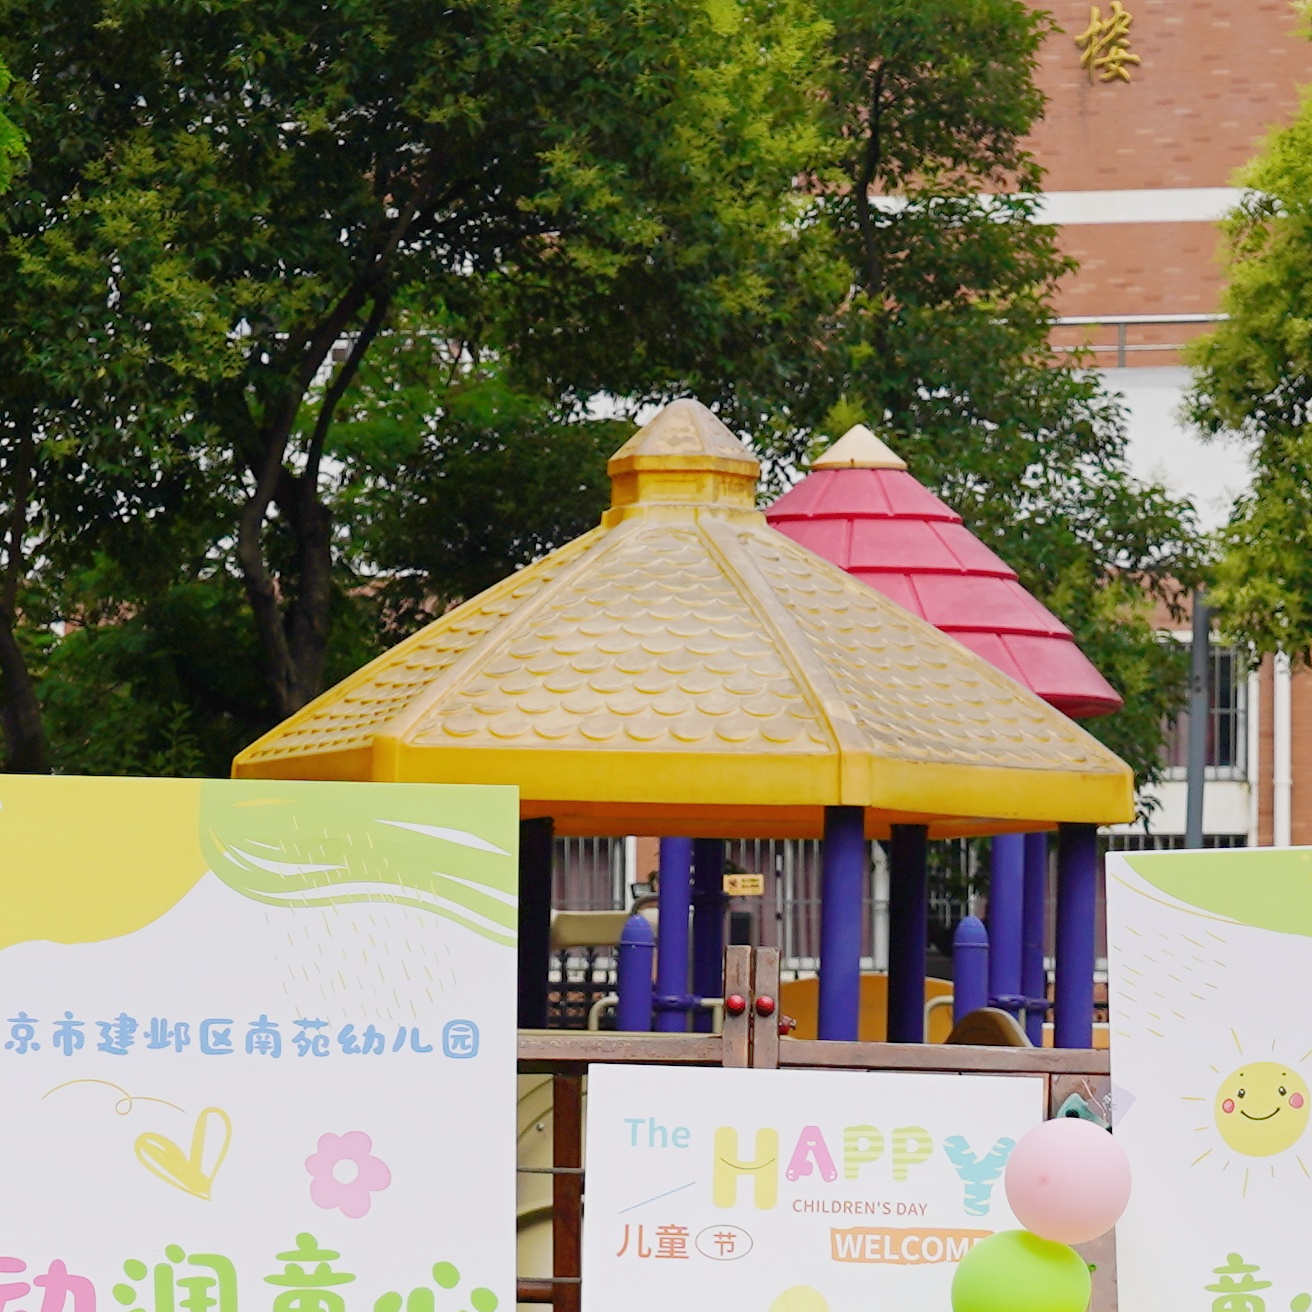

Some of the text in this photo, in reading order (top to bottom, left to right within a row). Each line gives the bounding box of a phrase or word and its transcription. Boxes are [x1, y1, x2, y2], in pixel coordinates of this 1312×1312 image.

[624, 1118, 691, 1149] The
[712, 1124, 1016, 1217] HAPPY
[792, 1199, 928, 1217] CHILDREN'S DAY
